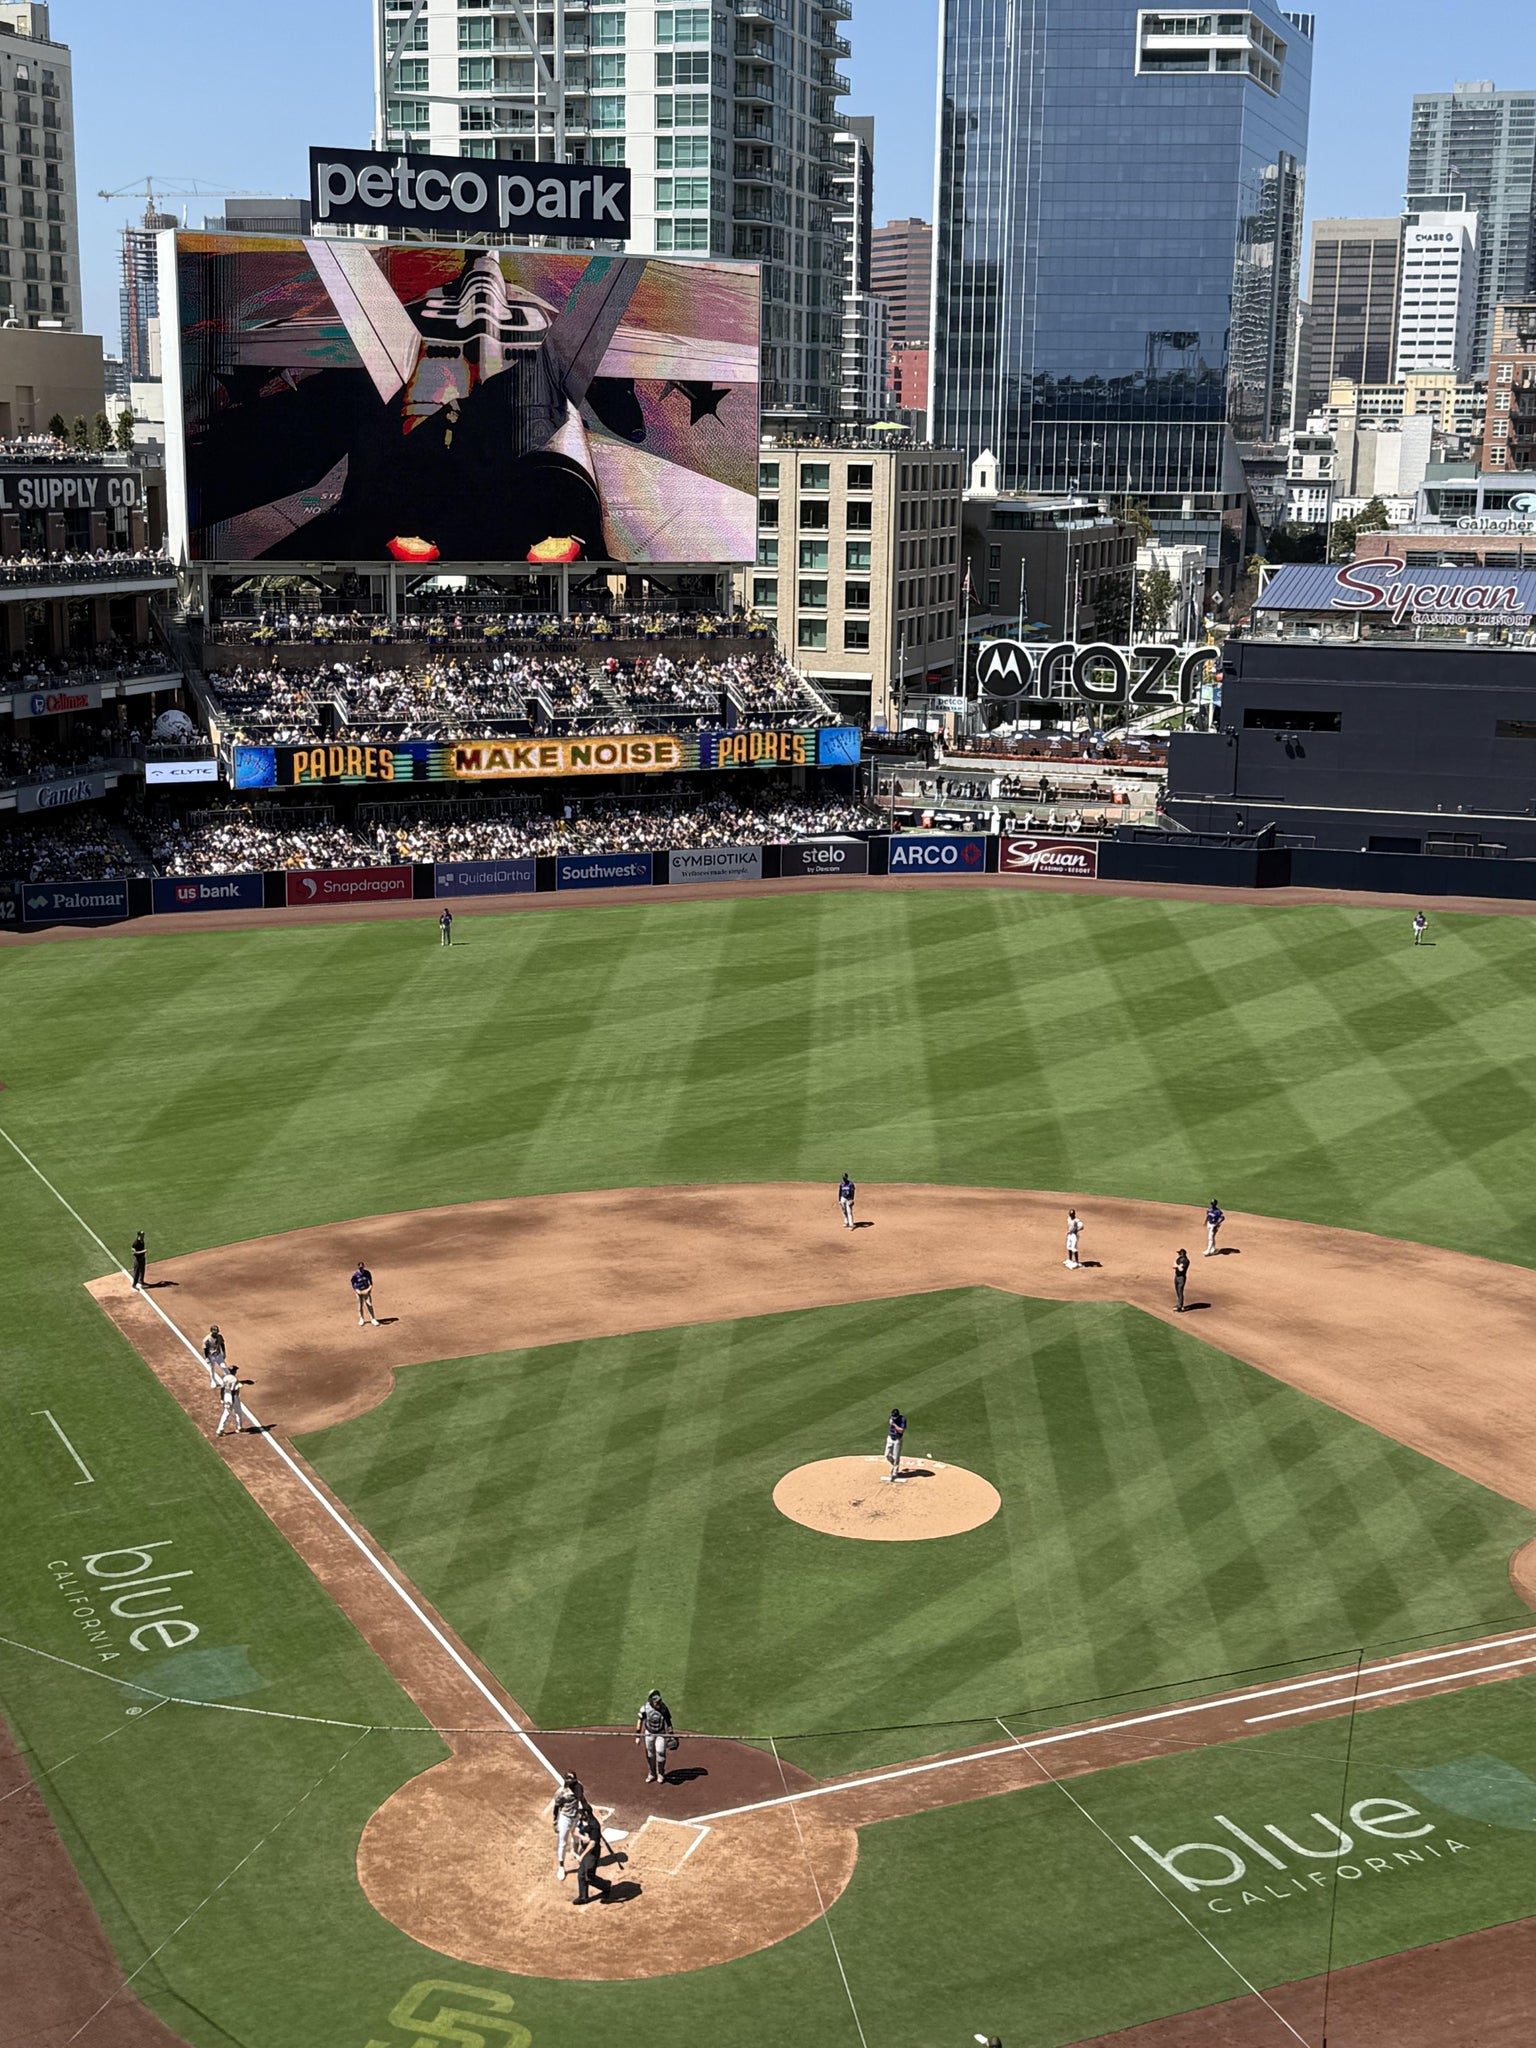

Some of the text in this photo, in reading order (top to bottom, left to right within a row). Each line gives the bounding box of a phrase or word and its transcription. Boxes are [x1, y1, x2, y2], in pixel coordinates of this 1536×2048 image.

[317, 157, 625, 228] petco park
[1415, 233, 1444, 242] CHASE
[18, 478, 98, 509] SUPPLY
[107, 478, 140, 507] CO.
[1457, 515, 1535, 532] Gallagher
[1331, 557, 1525, 625] Sycuan
[1412, 612, 1466, 626] CASINO
[532, 644, 577, 653] LANDING
[1038, 642, 1221, 704] razr
[46, 693, 89, 713] Calimax
[456, 742, 673, 772] MAKE NOISE
[718, 731, 806, 768] PADRES
[293, 746, 394, 784] PADRES
[36, 780, 93, 808] Canel's
[672, 852, 758, 868] CYMBIOTIKA
[802, 845, 845, 863] stelo
[891, 845, 958, 865] ARCO
[1006, 840, 1087, 872] Sycuan
[458, 870, 531, 885] QuidelOrtho
[562, 863, 636, 880] Southwest
[1040, 865, 1063, 873] CASINO
[178, 883, 239, 899] us bank
[323, 879, 405, 894] Snapdragon
[53, 893, 124, 909] Palomar
[81, 1539, 200, 1652] blue
[47, 1560, 120, 1662] CALIFORNIA
[1128, 1798, 1436, 1892] blue
[1207, 1838, 1471, 1913] CALIFORNIA
